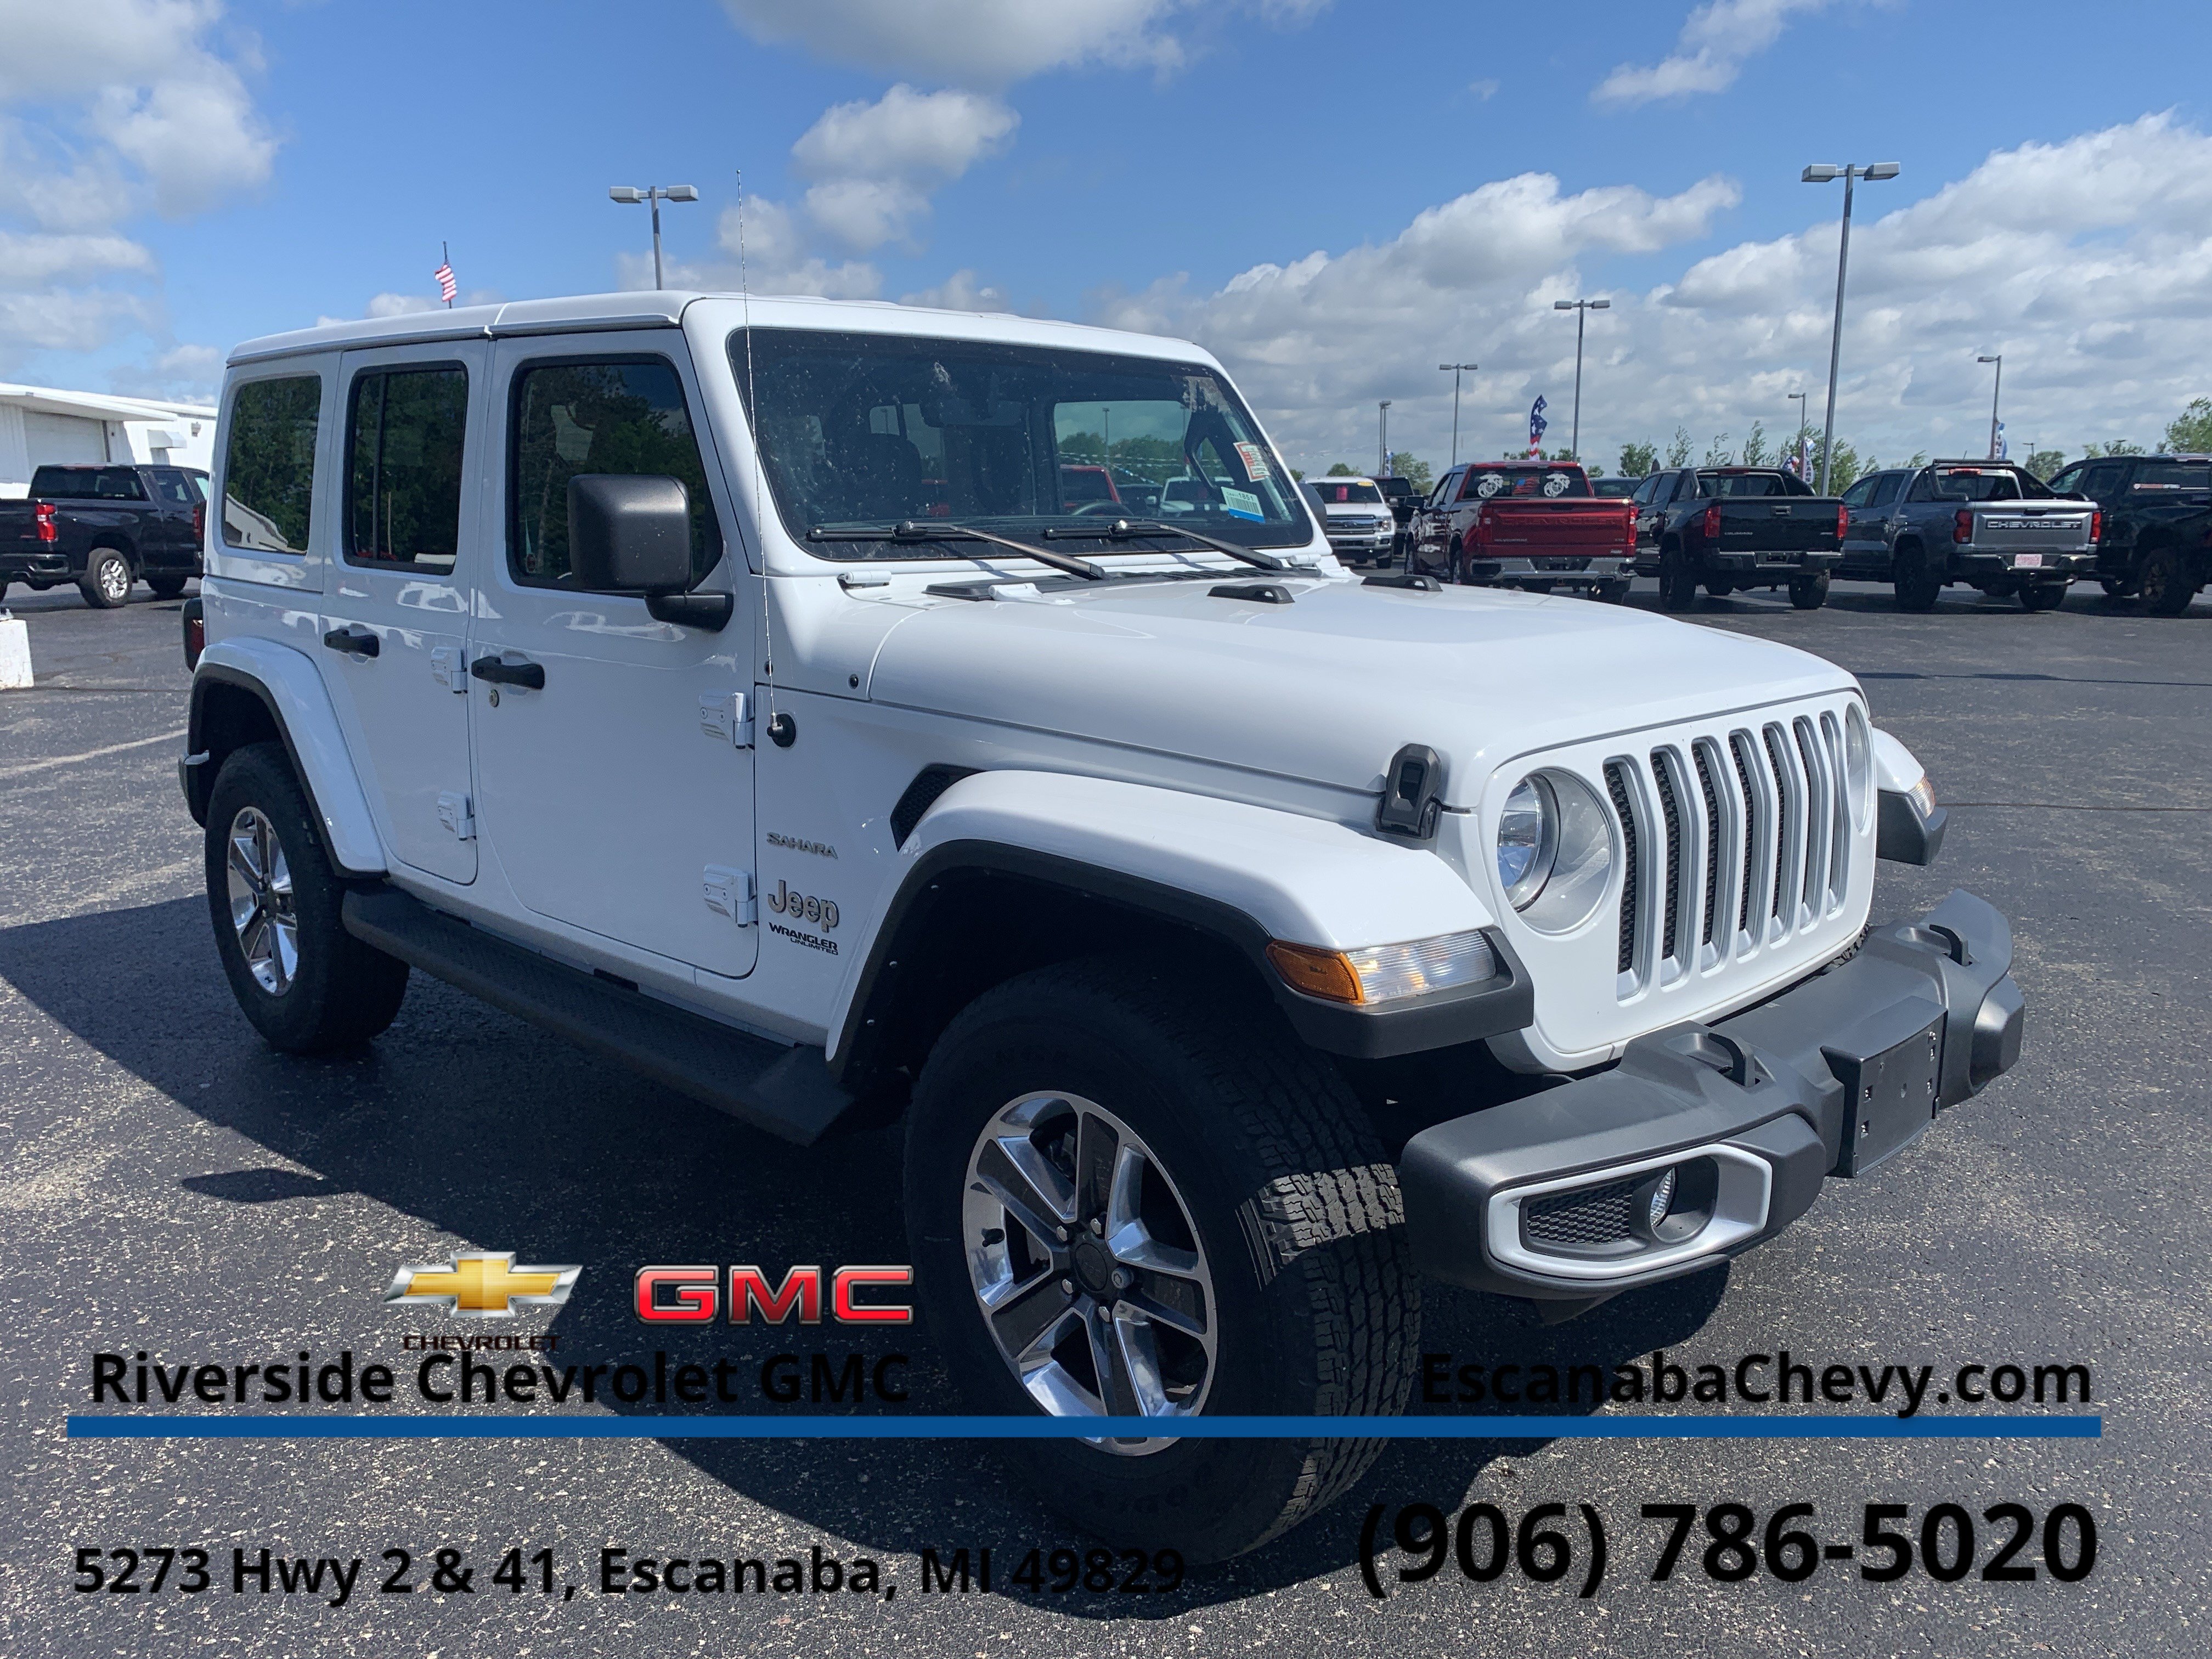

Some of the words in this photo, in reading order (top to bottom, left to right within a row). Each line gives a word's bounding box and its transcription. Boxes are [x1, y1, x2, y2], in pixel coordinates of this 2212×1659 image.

[766, 832, 838, 860] SAHARA
[768, 879, 839, 933] Jeep
[769, 922, 838, 951] WRANGLER
[790, 937, 839, 956] UNLIMITED
